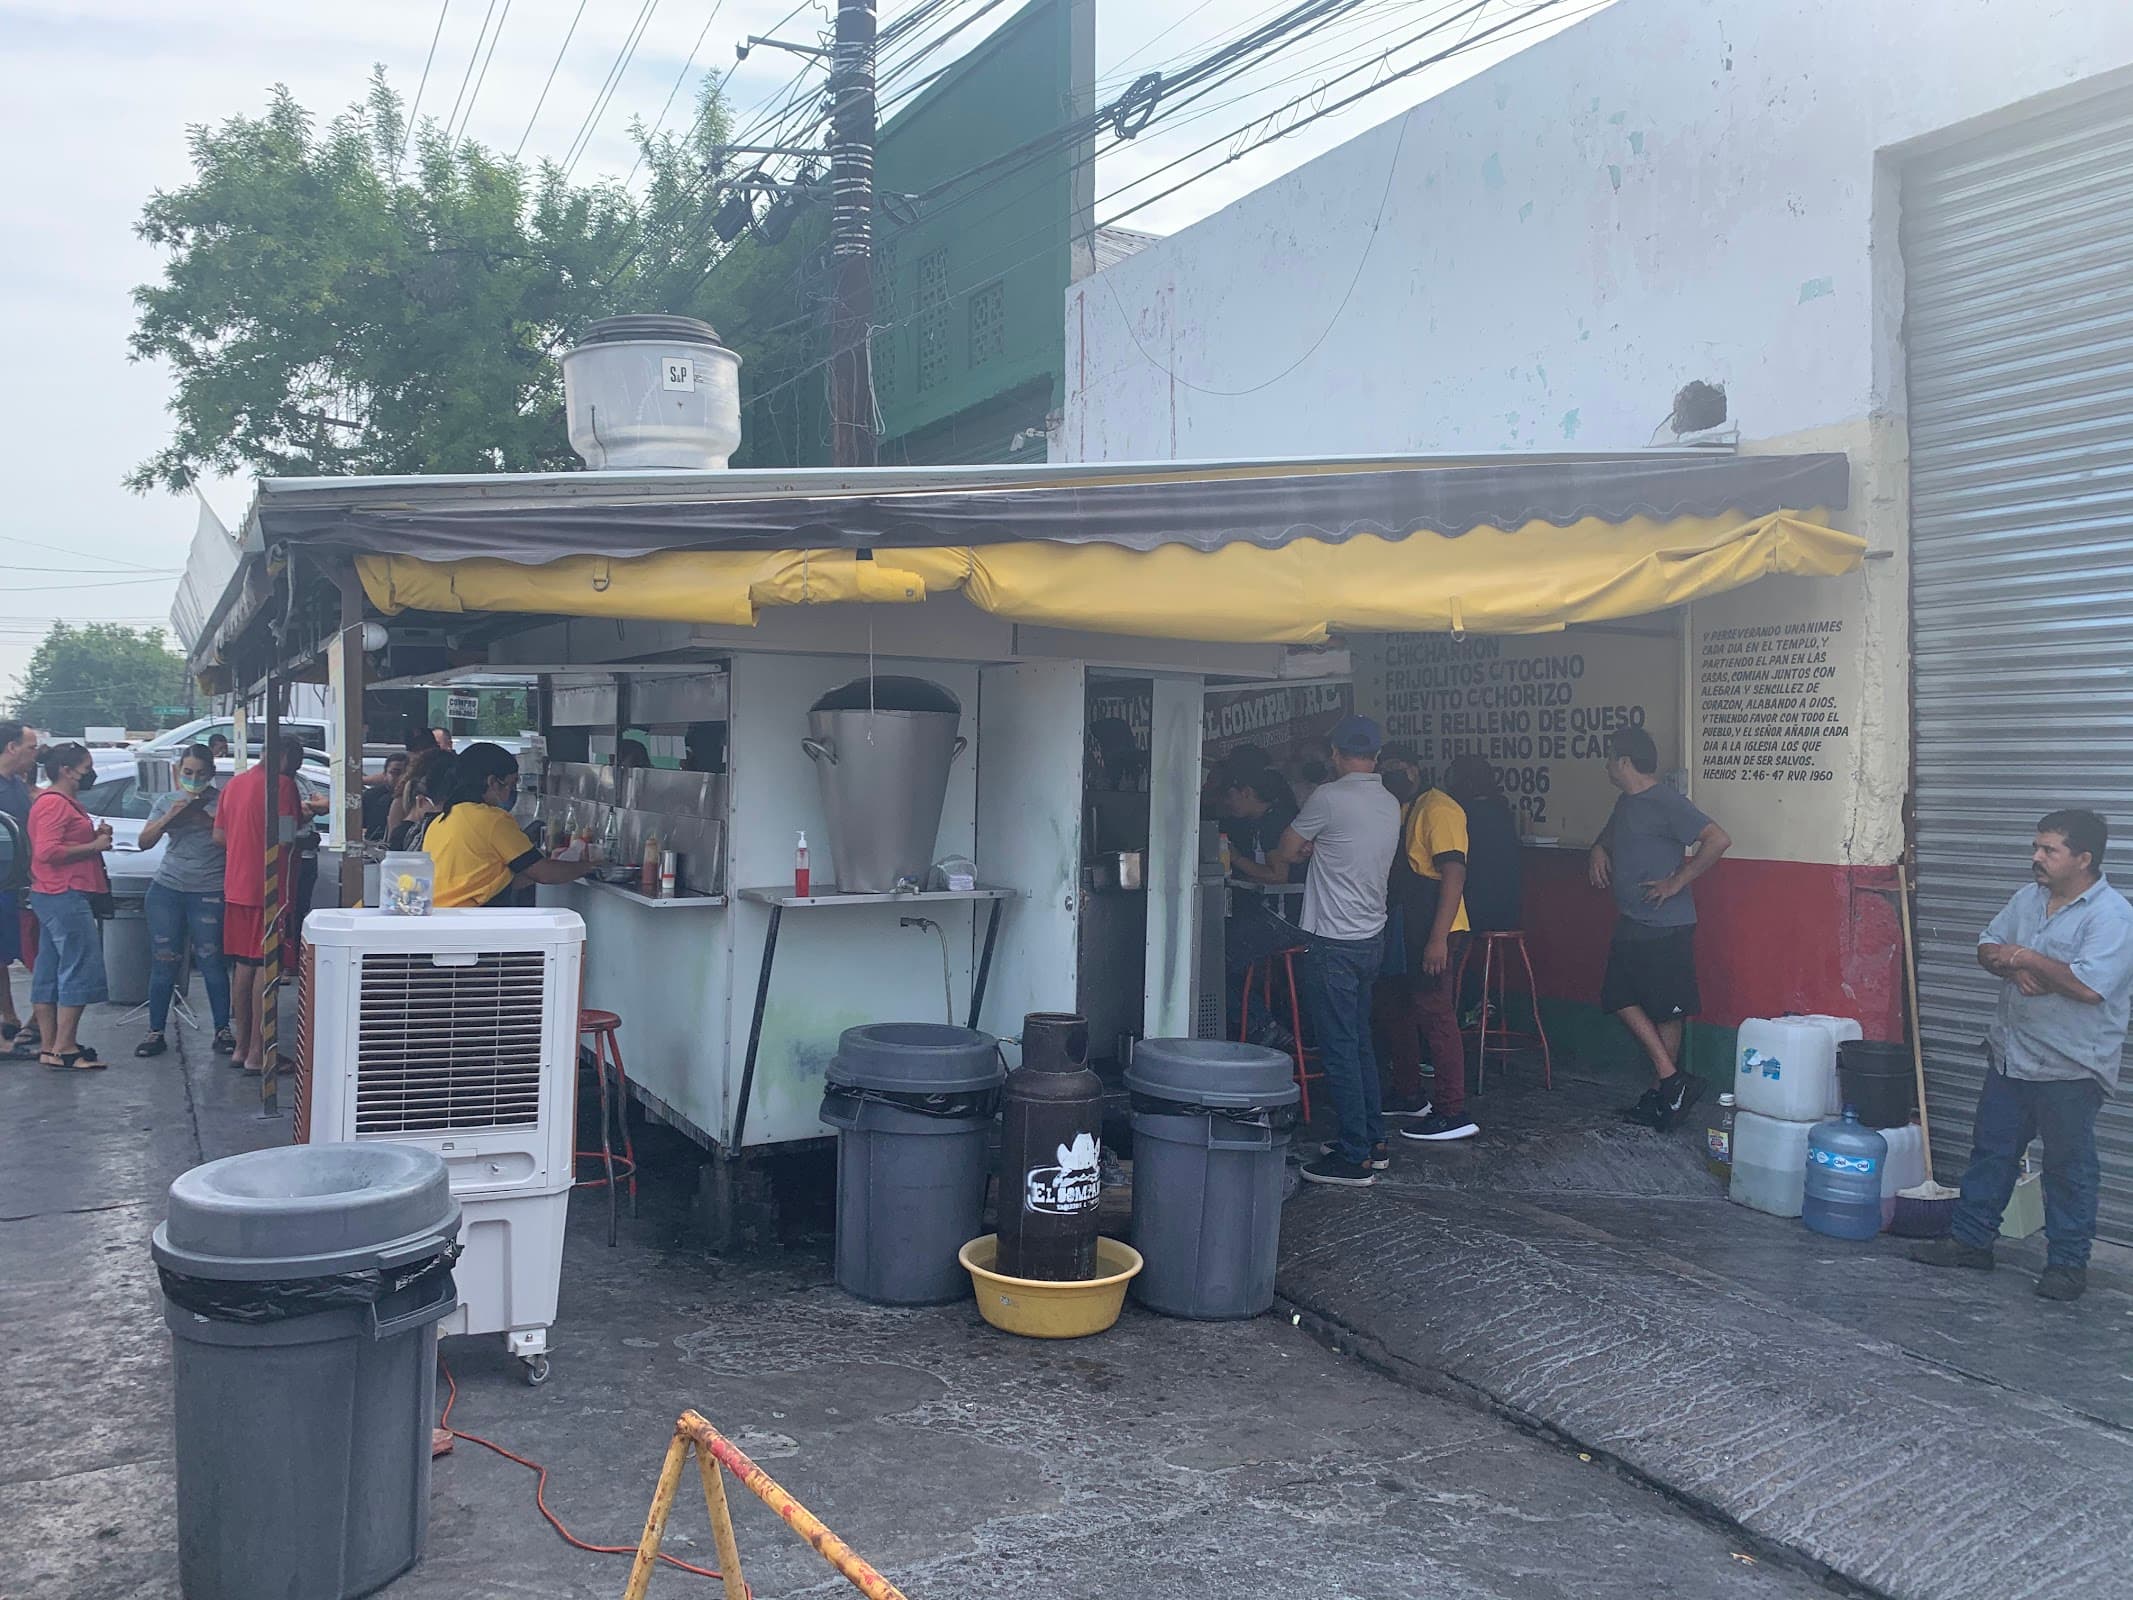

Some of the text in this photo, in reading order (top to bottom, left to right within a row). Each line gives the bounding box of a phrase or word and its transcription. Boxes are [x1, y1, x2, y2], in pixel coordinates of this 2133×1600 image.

[1703, 620, 1843, 641] Y PERSEVERANDO UNANIMES
[1702, 644, 1725, 656] CADA
[1727, 642, 1743, 654] DIA
[1745, 640, 1759, 653] EN
[1761, 640, 1773, 652] EL
[1822, 636, 1830, 648] Y
[1702, 651, 1827, 670] PARTIENDO EL PAN EN LAS
[1385, 662, 1485, 691] FRIJOLITOS
[1731, 669, 1770, 682] COMIAN
[1771, 667, 1811, 681] JUNTOS
[1813, 666, 1836, 679] CON
[1701, 682, 1820, 697] ALEGRIA Y SENCILLEZ DE
[1385, 688, 1462, 713] HUEVITO
[1746, 698, 1797, 710] ALABANDO
[1799, 698, 1806, 709] A
[1385, 705, 1646, 737] CHILE RELLENO DE QUESO
[1702, 712, 1840, 724] Y TENIENDO FAVOR CON TODO EL
[1735, 727, 1741, 737] Y
[1743, 726, 1752, 737] EL
[1754, 723, 1782, 737] SEÑOR
[1784, 723, 1820, 737] AÑADIA
[1823, 726, 1849, 737] CADA
[1441, 735, 1533, 761] RELLENO
[1538, 735, 1567, 760] DE
[1703, 741, 1822, 753] DIA A LA IGLESIA LOS QUE
[1703, 756, 1741, 766] HABIAN
[1743, 756, 1754, 766] DE
[1756, 756, 1773, 766] SER
[1703, 769, 1737, 780] HECHOS
[1788, 771, 1806, 782] RVR
[1810, 771, 1833, 781] 1960
